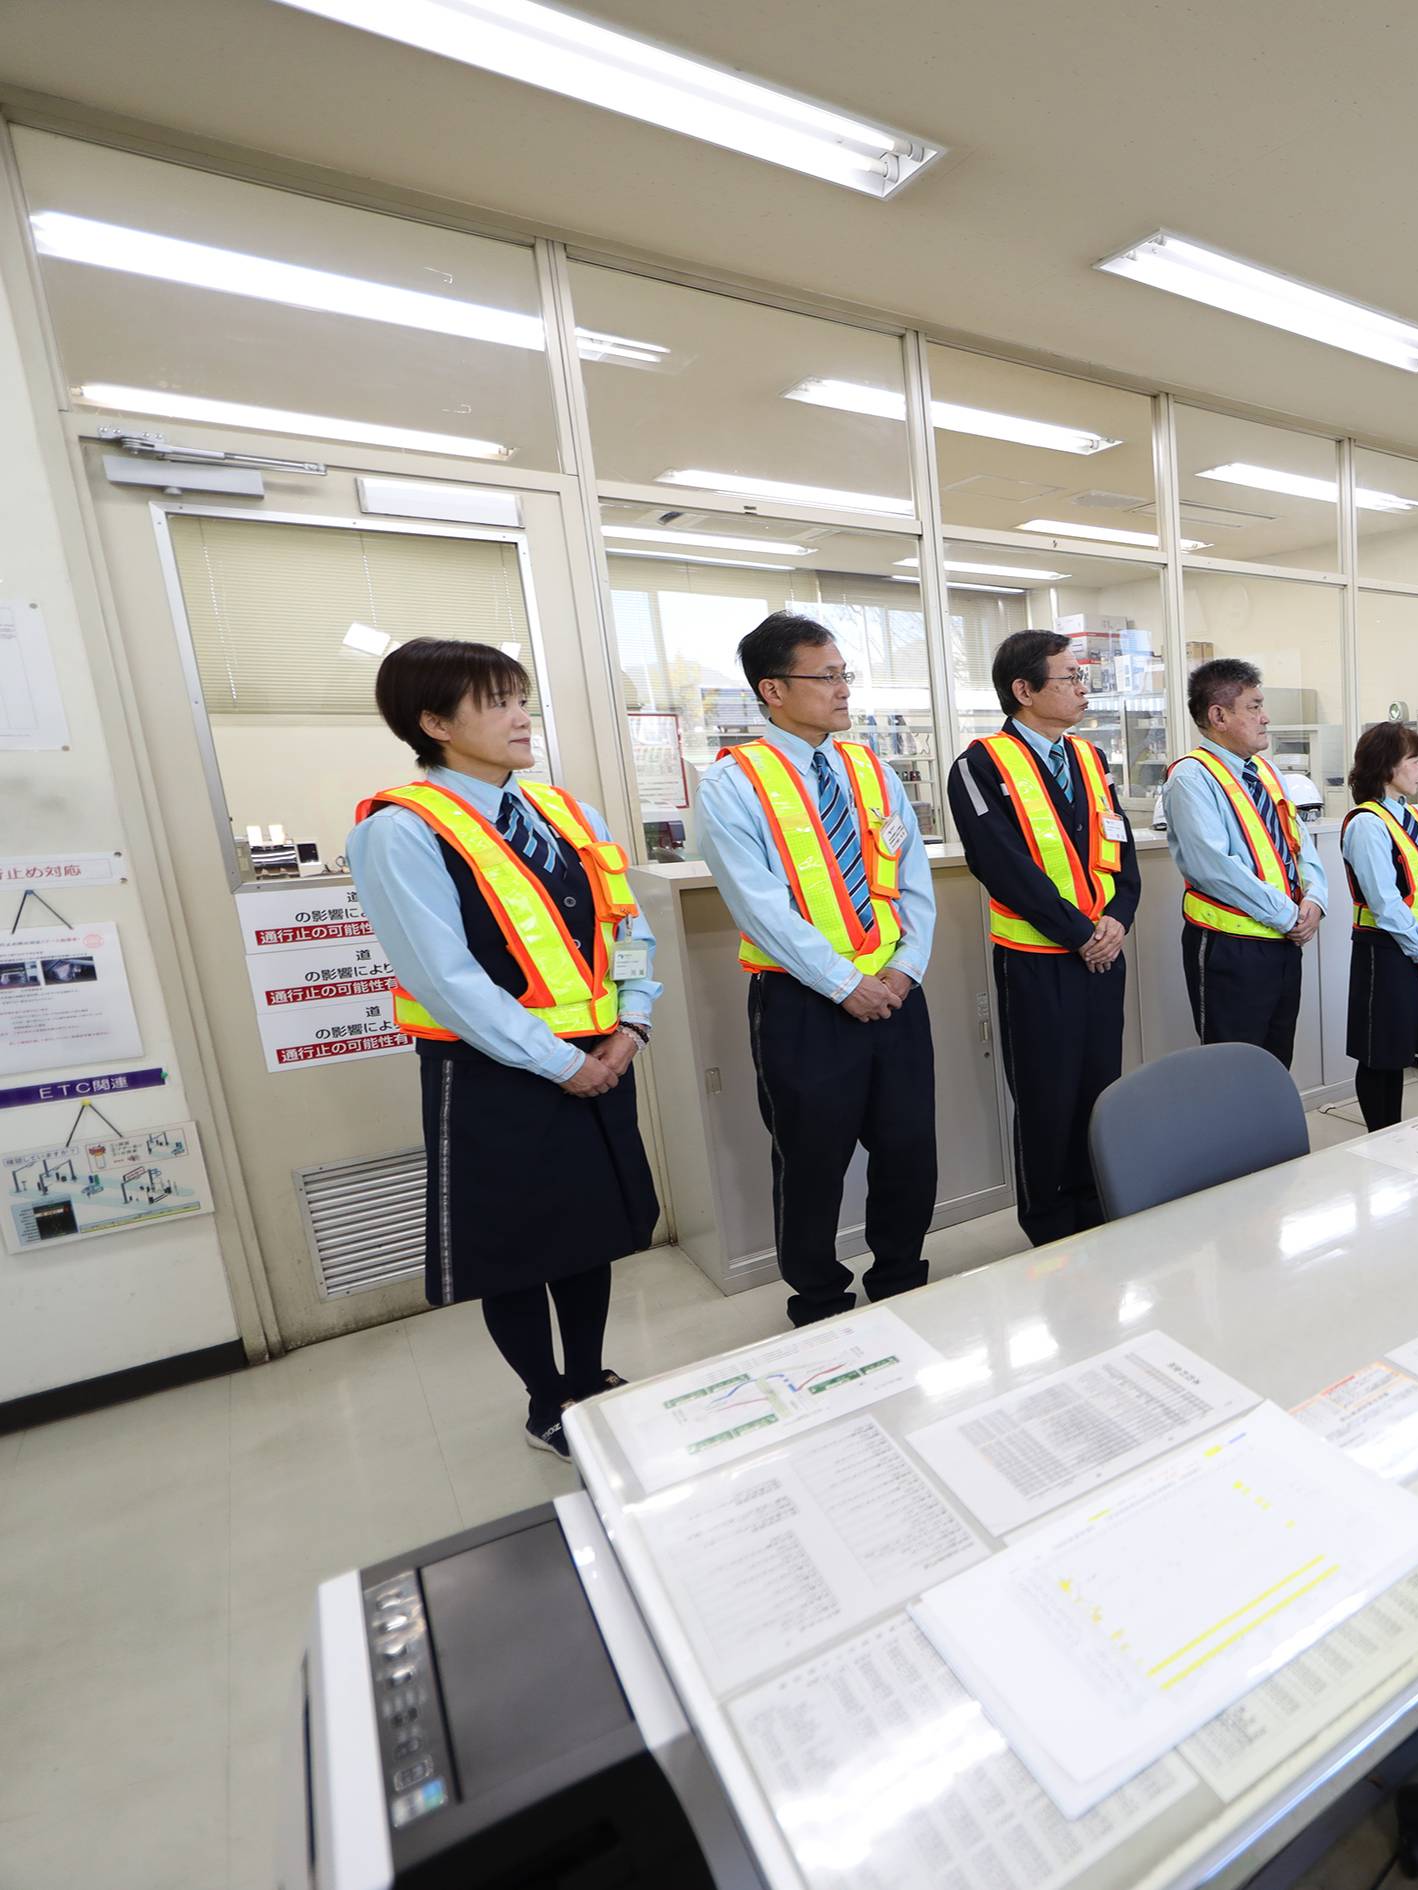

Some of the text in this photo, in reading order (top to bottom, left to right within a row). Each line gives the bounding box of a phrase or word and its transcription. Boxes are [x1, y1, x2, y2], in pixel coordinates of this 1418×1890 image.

[0, 864, 81, 880] 止め対応
[261, 922, 374, 944] 通行止の可能性
[356, 950, 371, 961] 道
[366, 1006, 381, 1017] 道
[316, 1020, 400, 1040] の影響によ
[282, 1034, 408, 1062] 通行止の可能性有
[39, 1076, 128, 1099] ETC関連
